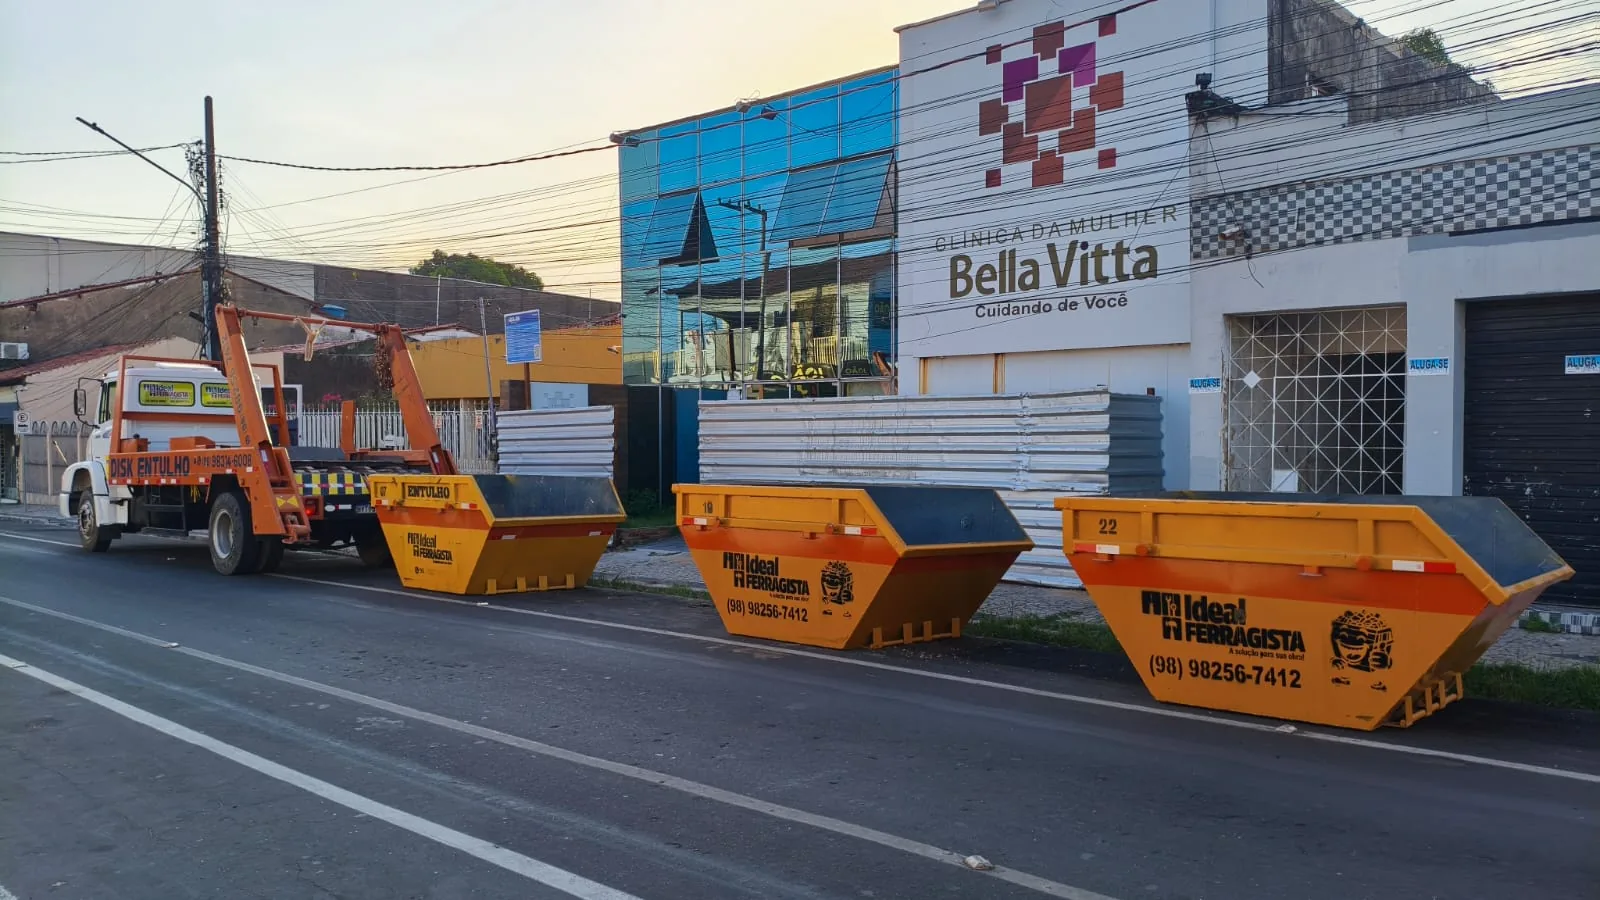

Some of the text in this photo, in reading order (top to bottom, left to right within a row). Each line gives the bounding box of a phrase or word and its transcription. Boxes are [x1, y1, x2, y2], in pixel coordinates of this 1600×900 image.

[1032, 221, 1061, 240] DA
[1070, 205, 1176, 235] MULHER
[950, 239, 1158, 298] Bella Vitta
[975, 293, 1128, 318] Cuidando de Você
[1410, 358, 1449, 369] ALUGA-SE
[111, 458, 133, 478] DISK
[138, 455, 190, 478] ENTULHO
[408, 485, 450, 499] ENTULHO
[1099, 518, 1117, 535] 22
[420, 533, 437, 548] Ideal
[420, 547, 453, 561] FERRAGISTA
[746, 554, 779, 576] Ideal
[746, 574, 810, 595] FERRAGISTA
[727, 598, 808, 622] (98) 98256-7412
[1184, 594, 1247, 625] Ideal
[1185, 621, 1306, 652] FERRAGISTA
[1149, 654, 1302, 688] (98) 98256-7412
